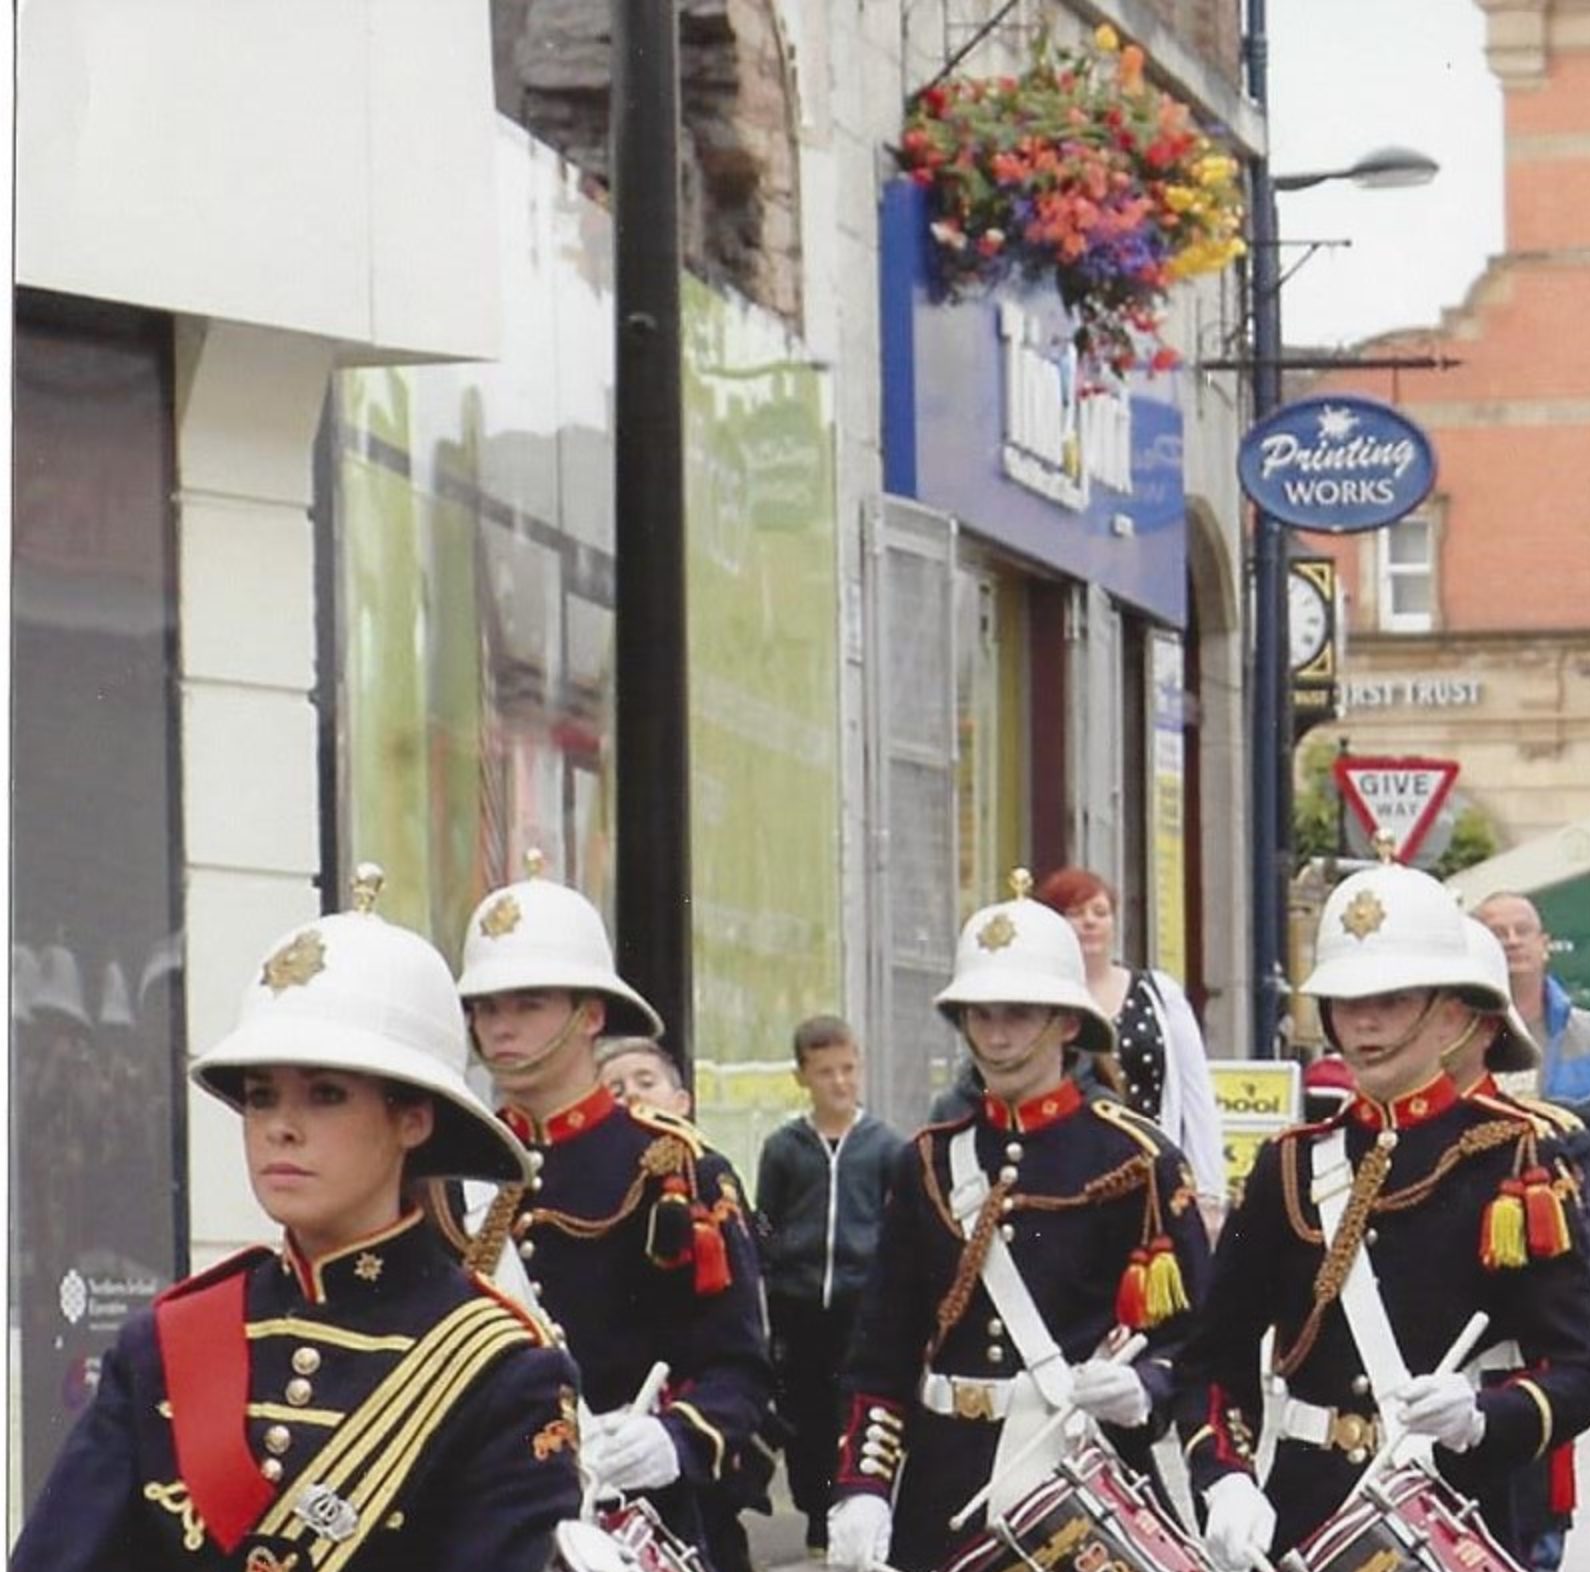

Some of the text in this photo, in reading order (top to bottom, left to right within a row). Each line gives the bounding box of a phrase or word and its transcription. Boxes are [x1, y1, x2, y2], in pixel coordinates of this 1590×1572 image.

[1261, 433, 1415, 480] Printing
[1284, 479, 1395, 506] WORKS
[1341, 681, 1393, 705] IRST
[1405, 680, 1479, 705] TRUST
[1360, 774, 1430, 796] GIVE
[1376, 802, 1419, 816] WAY
